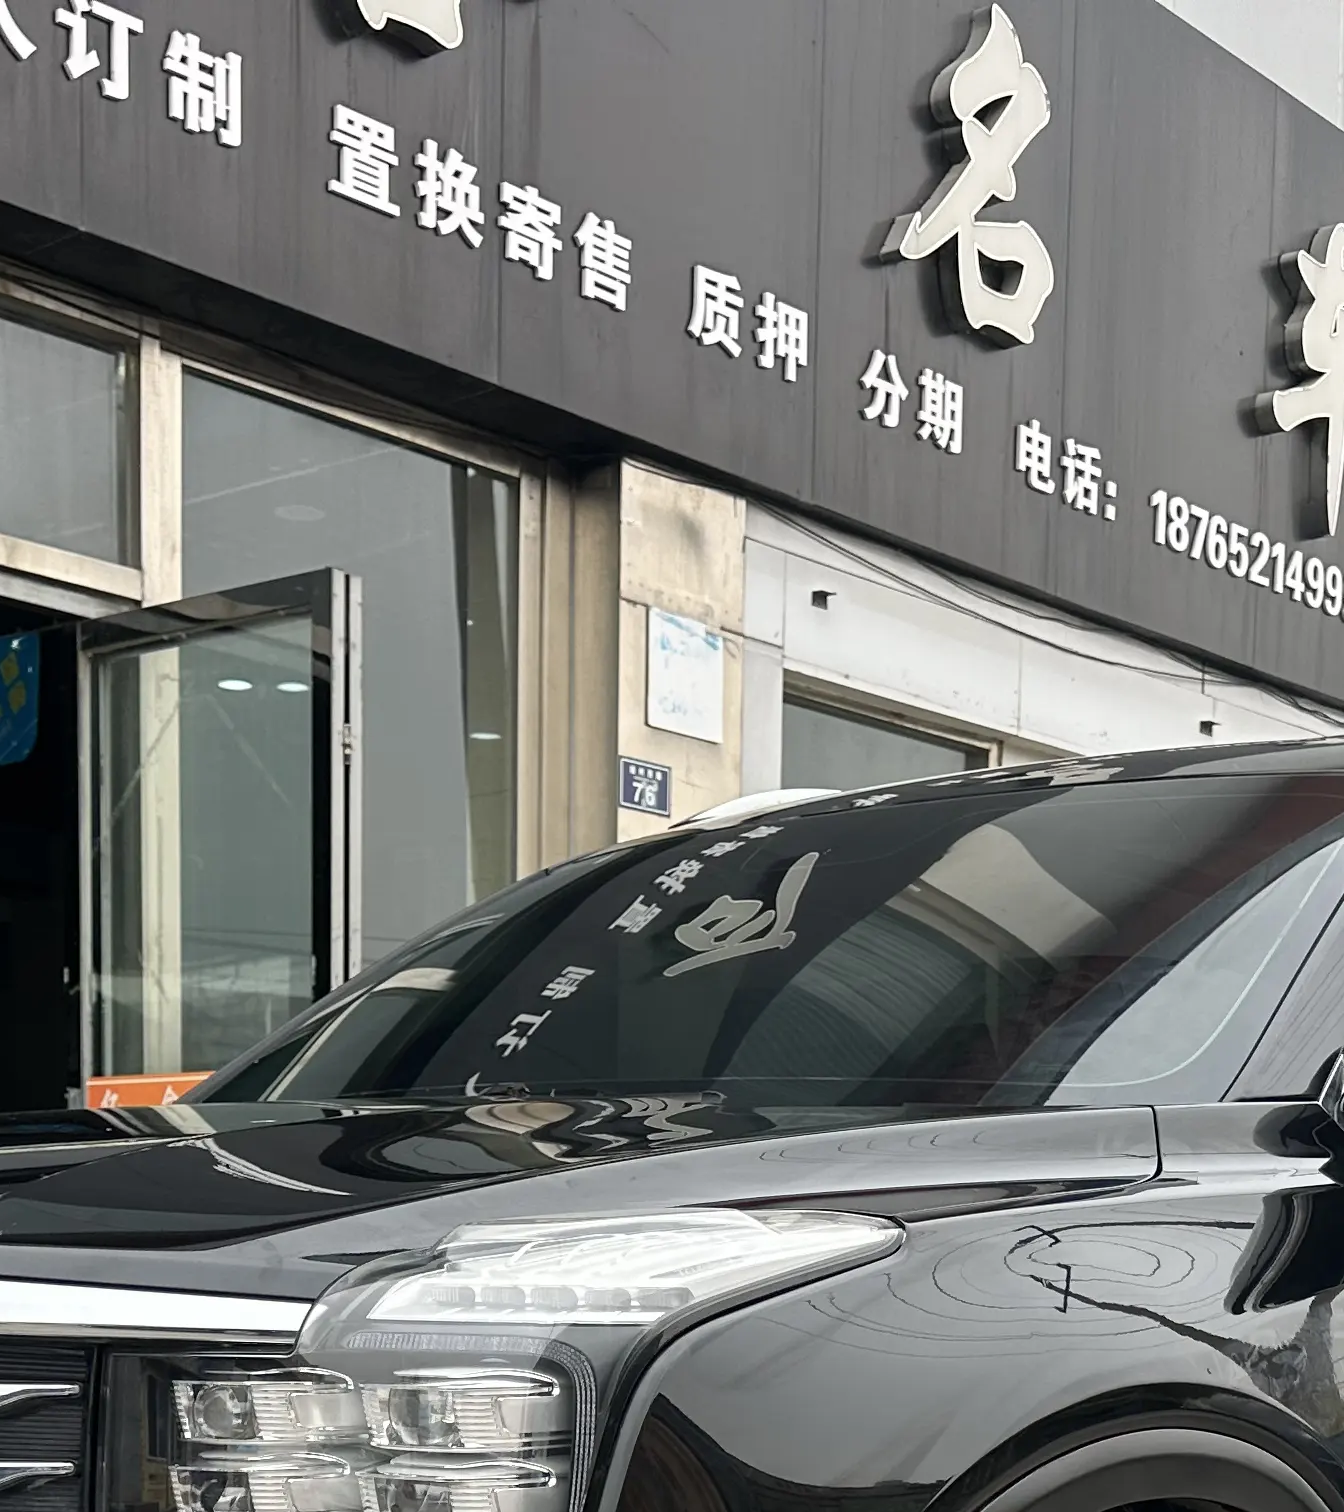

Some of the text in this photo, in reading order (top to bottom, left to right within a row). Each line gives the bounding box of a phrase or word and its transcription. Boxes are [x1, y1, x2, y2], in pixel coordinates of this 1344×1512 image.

[327, 104, 633, 311] 置换寄售
[687, 265, 808, 383] 质押
[860, 349, 964, 454] 分期
